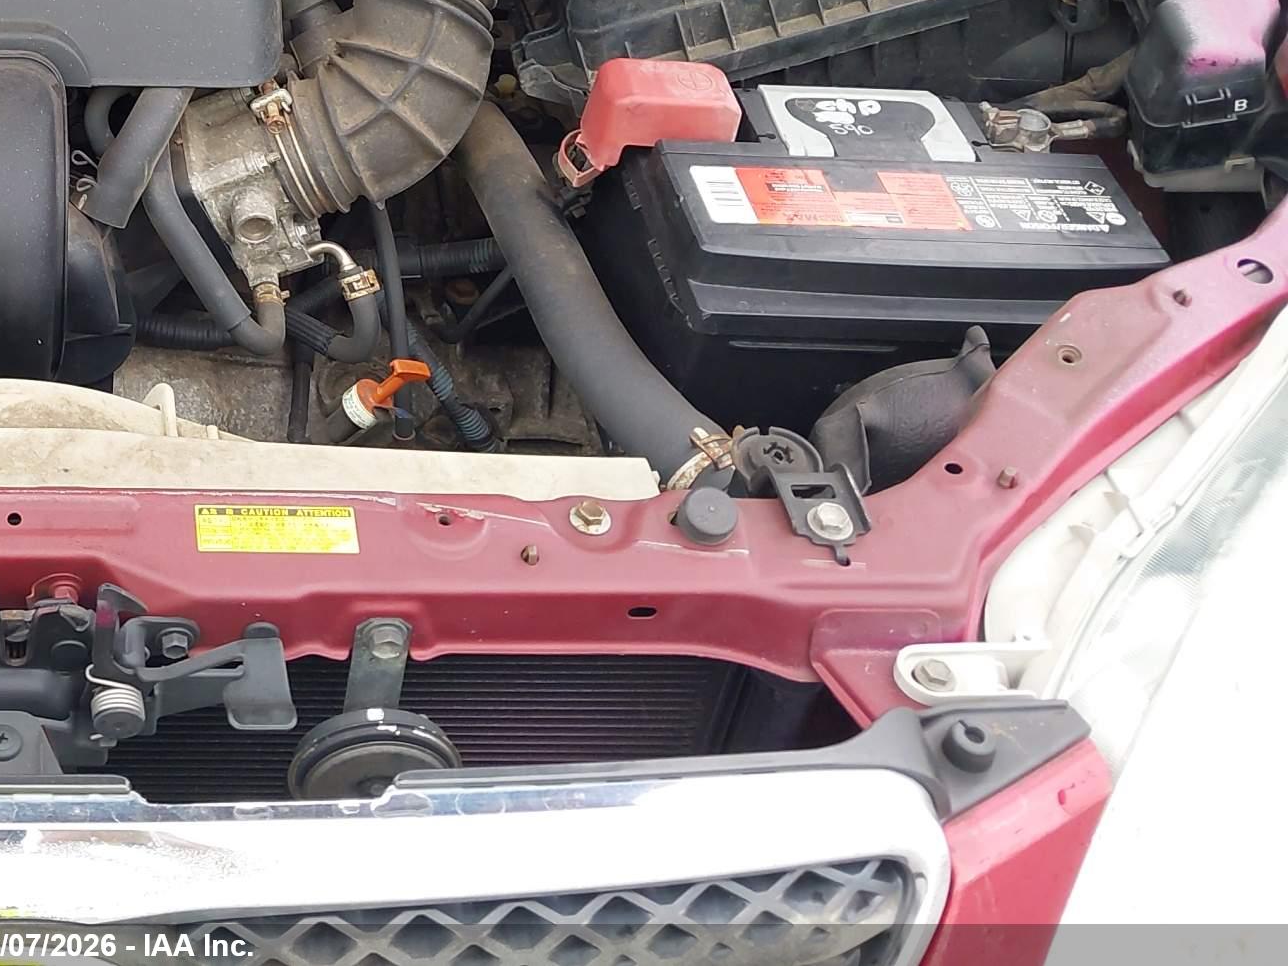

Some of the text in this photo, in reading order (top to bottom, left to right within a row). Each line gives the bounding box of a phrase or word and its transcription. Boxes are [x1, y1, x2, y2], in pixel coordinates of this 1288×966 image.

[1234, 98, 1249, 112] B
[240, 508, 289, 516] CAUTION
[295, 509, 351, 517] ATTENTION
